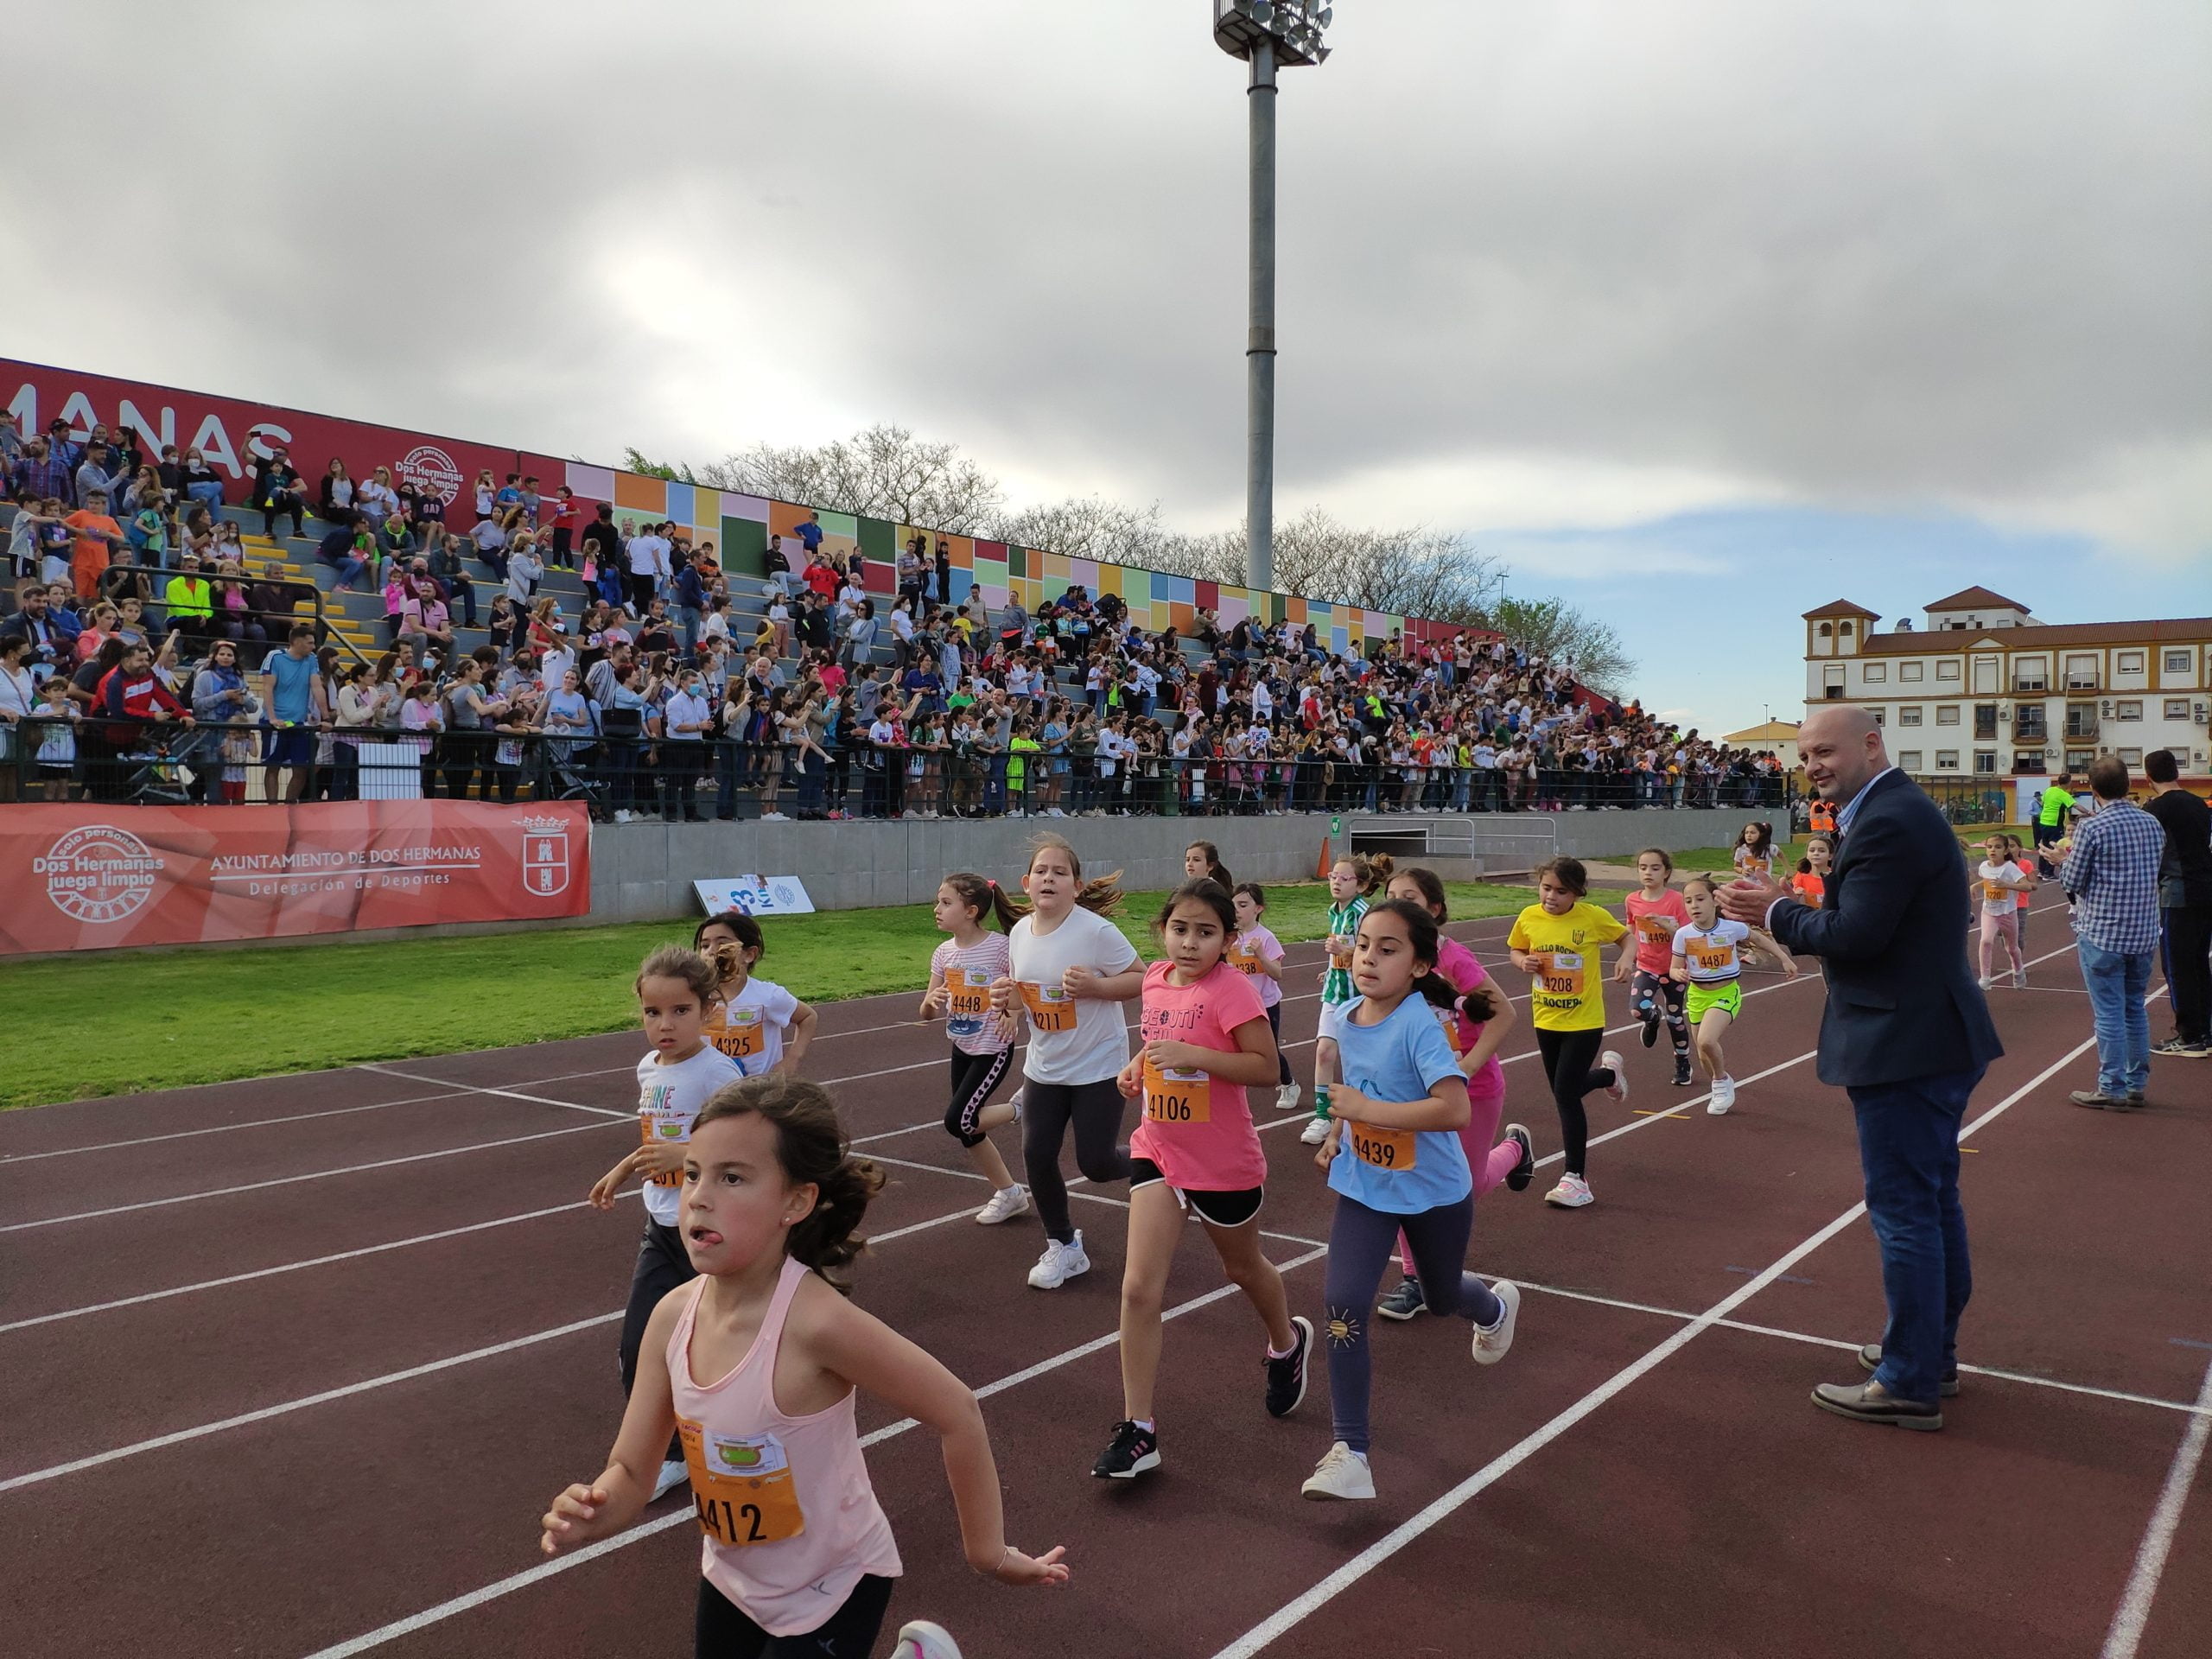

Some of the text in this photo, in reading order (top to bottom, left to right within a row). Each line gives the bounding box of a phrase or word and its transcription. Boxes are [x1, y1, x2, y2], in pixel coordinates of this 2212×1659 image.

[423, 449, 452, 469] personas
[395, 461, 464, 482] Dos Hermanas
[403, 473, 459, 493] juega limpio
[423, 504, 441, 514] GAP
[58, 830, 140, 856] solo personas
[33, 855, 165, 874] Dos Hermanas
[210, 846, 481, 871] AYUNTAMIENTO DE DOS HERMANAS
[47, 870, 156, 893] juega limpio
[250, 873, 450, 896] Delegación de Deportes
[1700, 954, 1725, 967] 4487
[1544, 976, 1573, 992] 4208
[952, 995, 981, 1012] 4448
[715, 1037, 750, 1056] 4325
[1149, 1094, 1191, 1120] 4106
[1353, 1135, 1395, 1166] 4439
